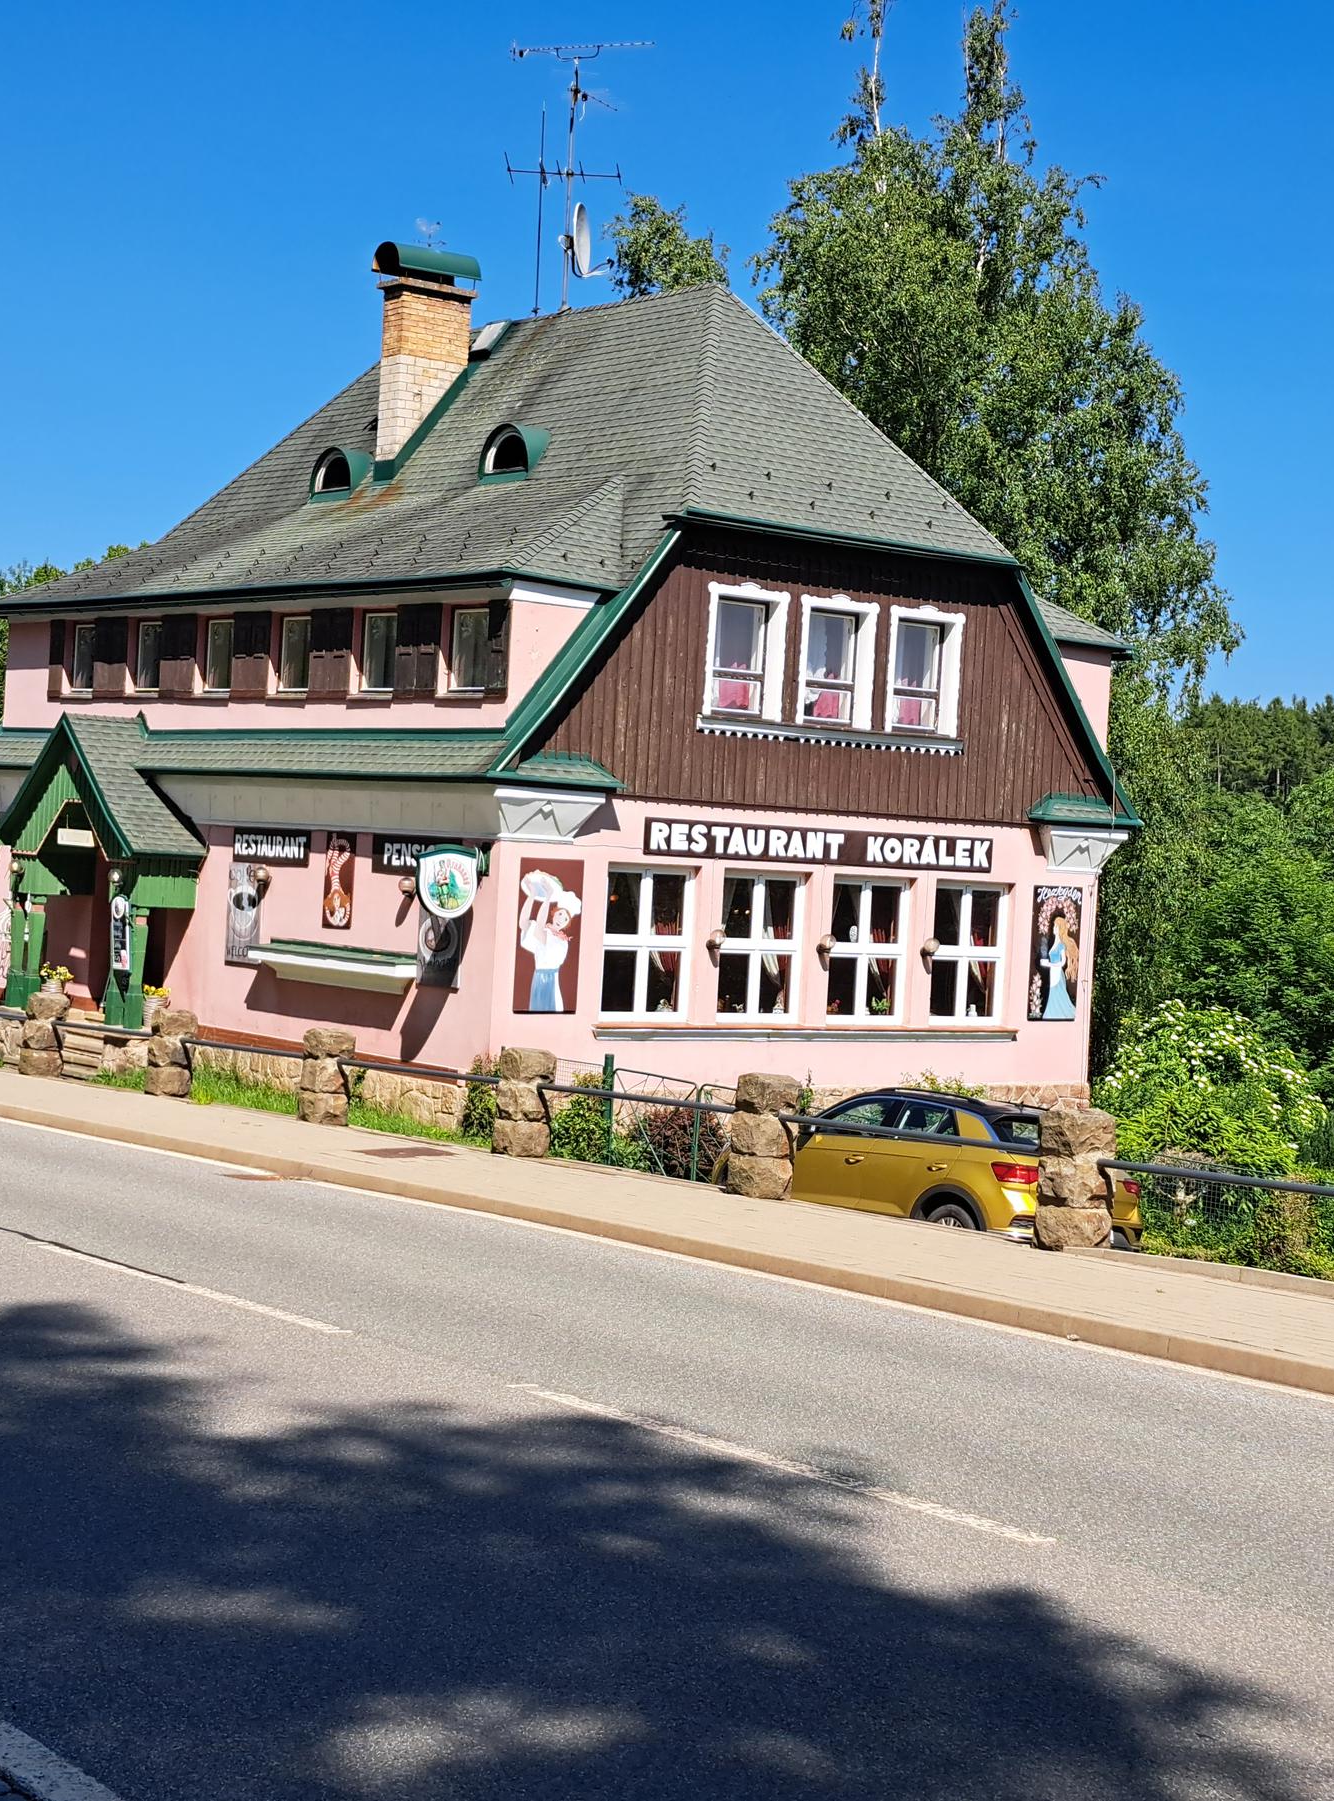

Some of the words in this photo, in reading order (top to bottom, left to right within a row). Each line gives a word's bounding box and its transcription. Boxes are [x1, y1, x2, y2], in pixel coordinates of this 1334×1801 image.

[234, 833, 308, 860] RESTAURANT
[649, 820, 845, 861] RESTAURANT
[867, 833, 992, 868] KORÁLEK
